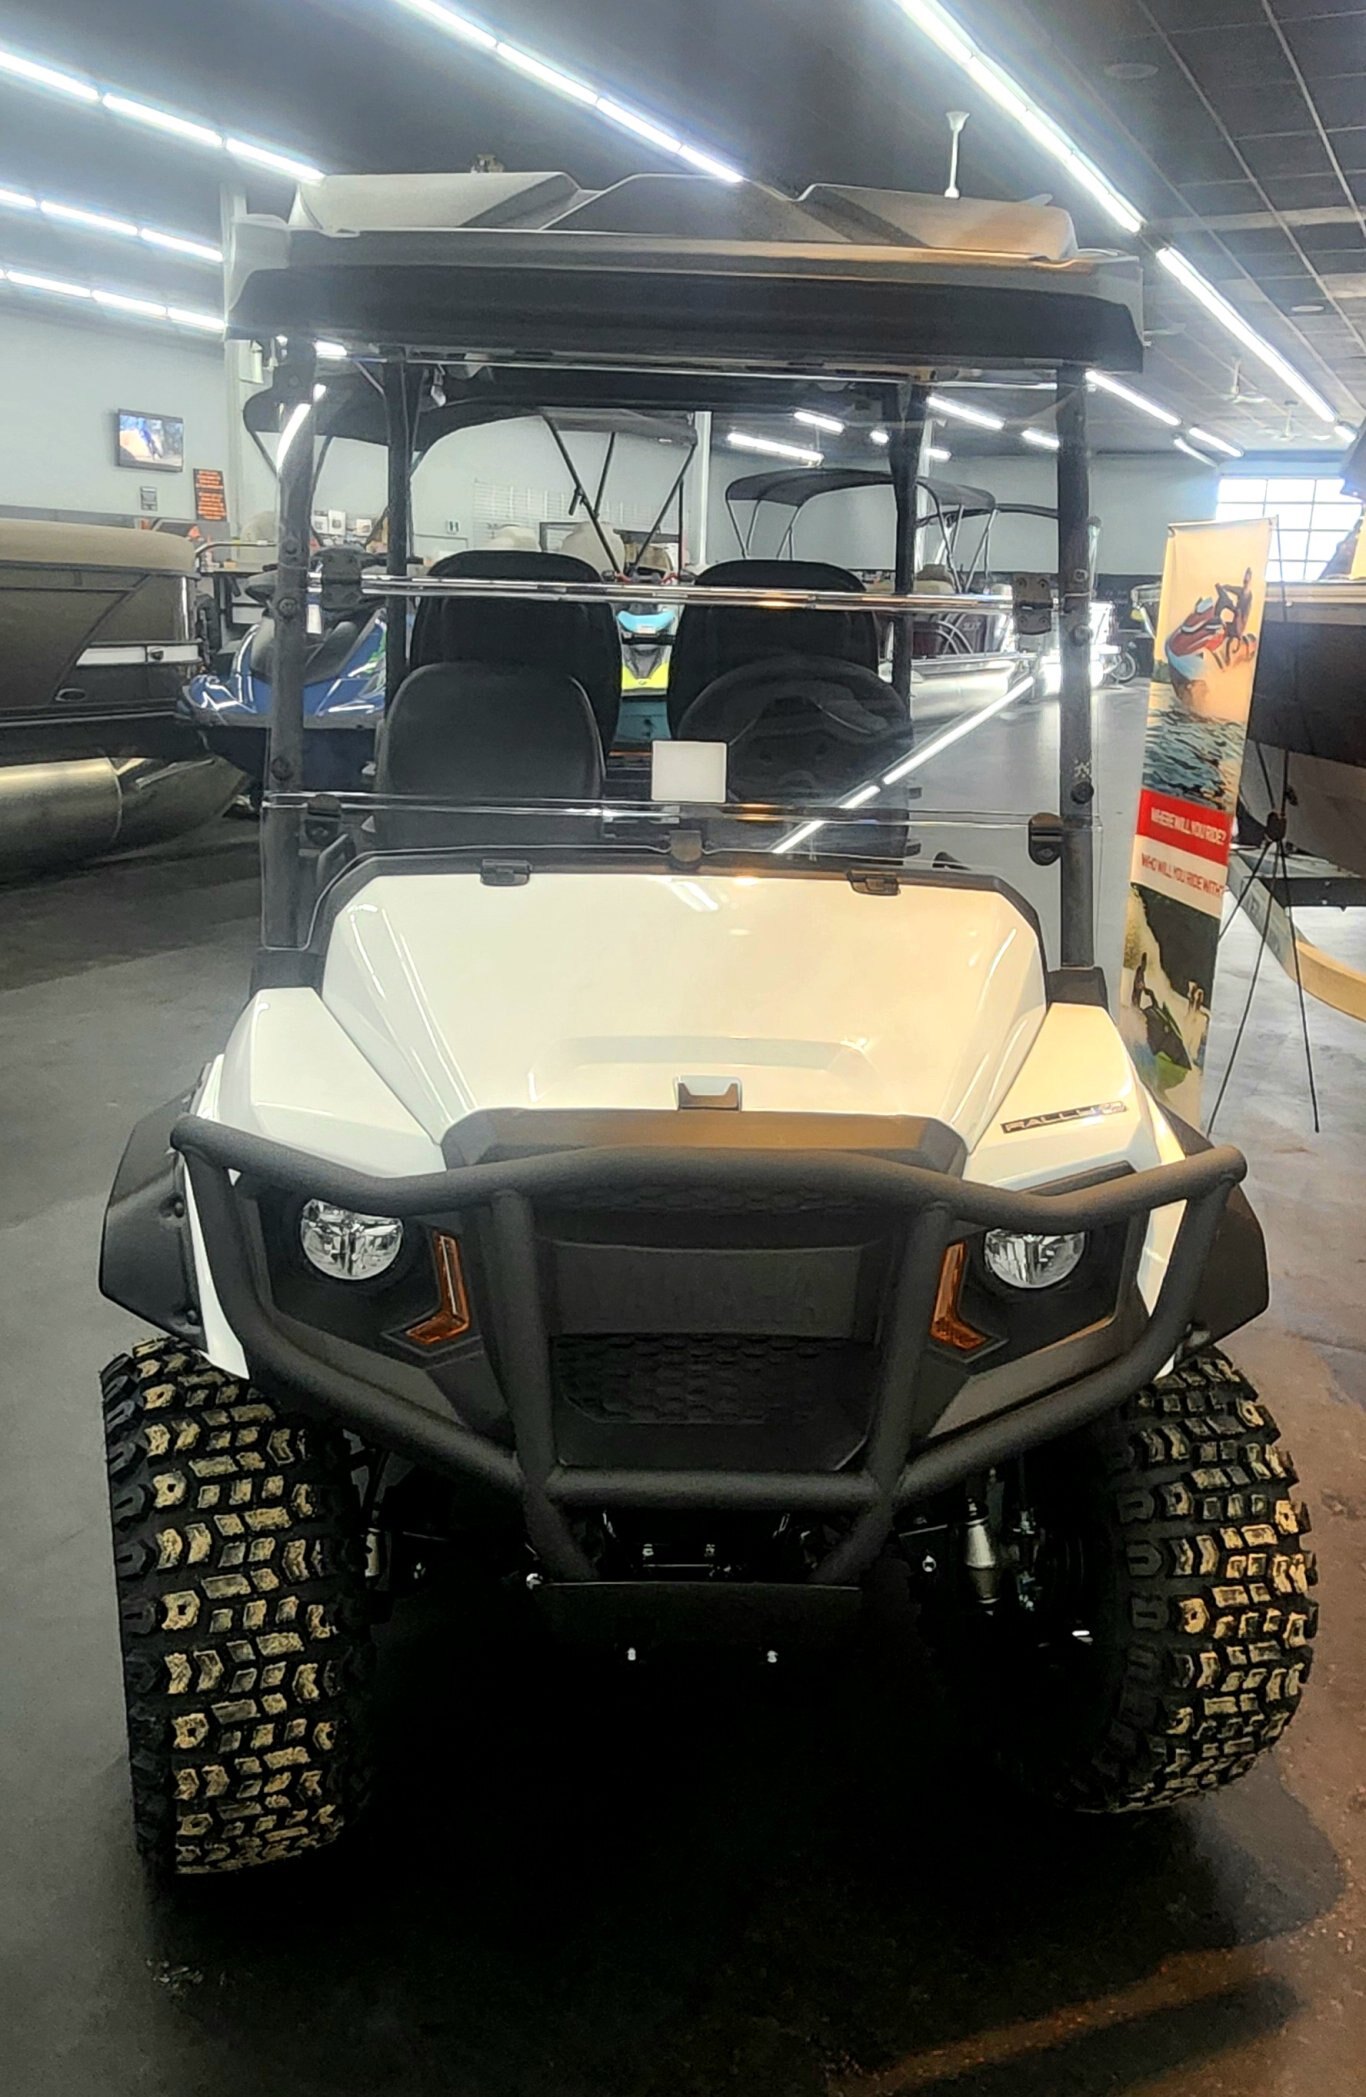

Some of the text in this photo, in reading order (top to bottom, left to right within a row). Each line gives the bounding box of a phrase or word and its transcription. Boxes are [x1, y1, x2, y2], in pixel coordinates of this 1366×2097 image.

[1175, 816, 1191, 835] WILL
[1191, 821, 1205, 839] YOU
[1205, 825, 1226, 846] RIDE?
[1142, 852, 1158, 871] WHO
[1157, 860, 1172, 879] WILL
[1173, 866, 1186, 884] YOU
[1186, 871, 1202, 890] RIDE
